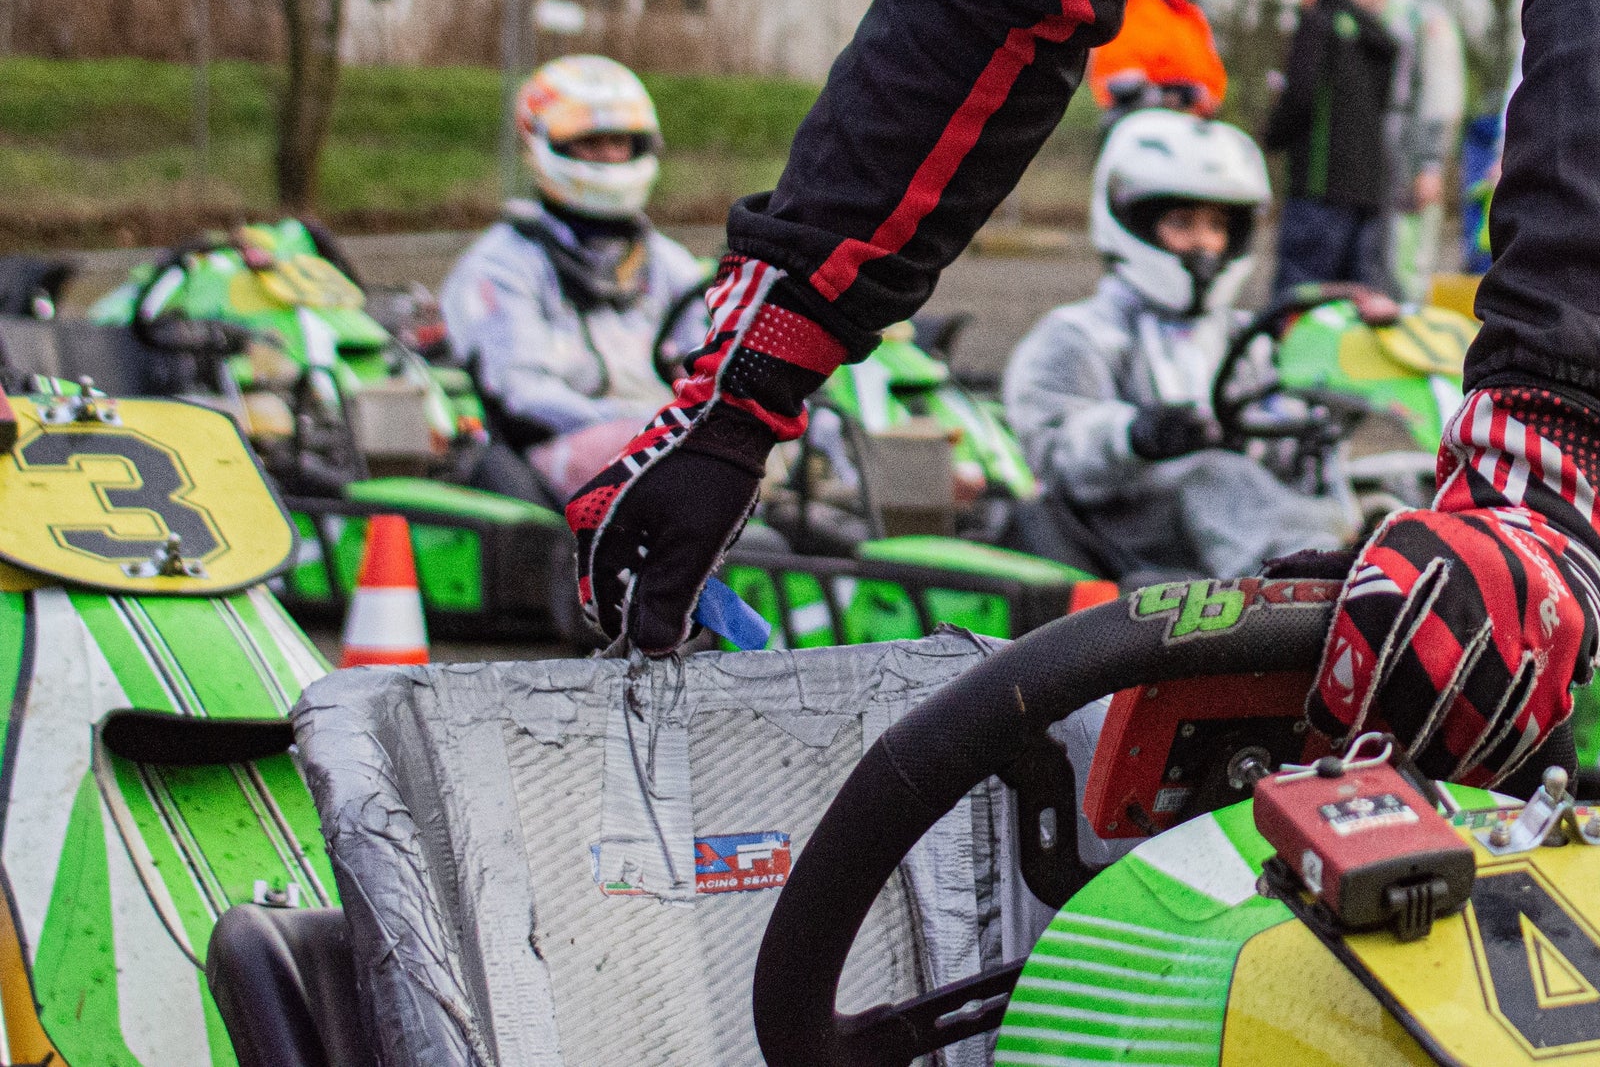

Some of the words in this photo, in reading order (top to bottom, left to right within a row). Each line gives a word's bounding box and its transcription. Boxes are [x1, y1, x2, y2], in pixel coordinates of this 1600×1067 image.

[11, 422, 230, 564] 3
[697, 878, 738, 889] ACING
[743, 873, 784, 886] SEATS
